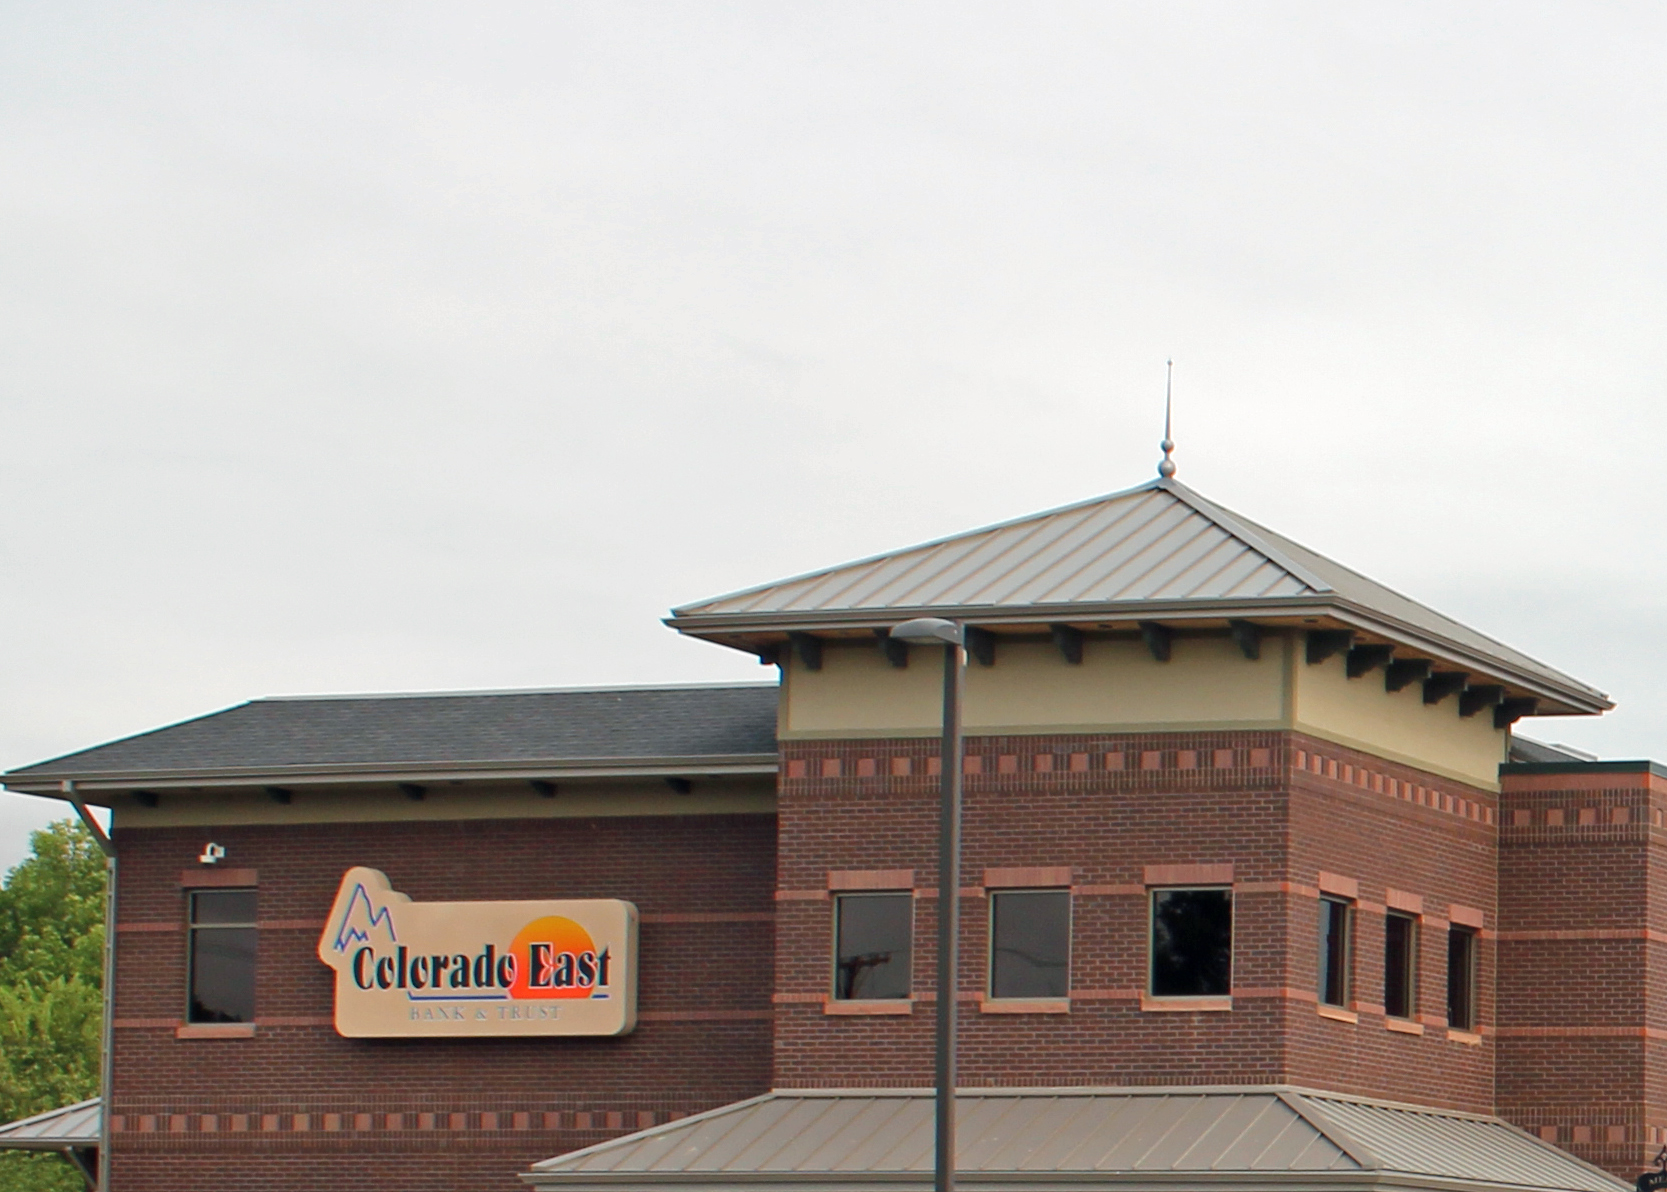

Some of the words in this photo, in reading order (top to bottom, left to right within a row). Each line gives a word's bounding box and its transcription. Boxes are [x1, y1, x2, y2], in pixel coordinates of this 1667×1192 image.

[353, 943, 516, 989] Colorado
[528, 942, 611, 989] East
[410, 1006, 466, 1020] BANK
[475, 1007, 487, 1019] &
[498, 1006, 562, 1019] TRUST
